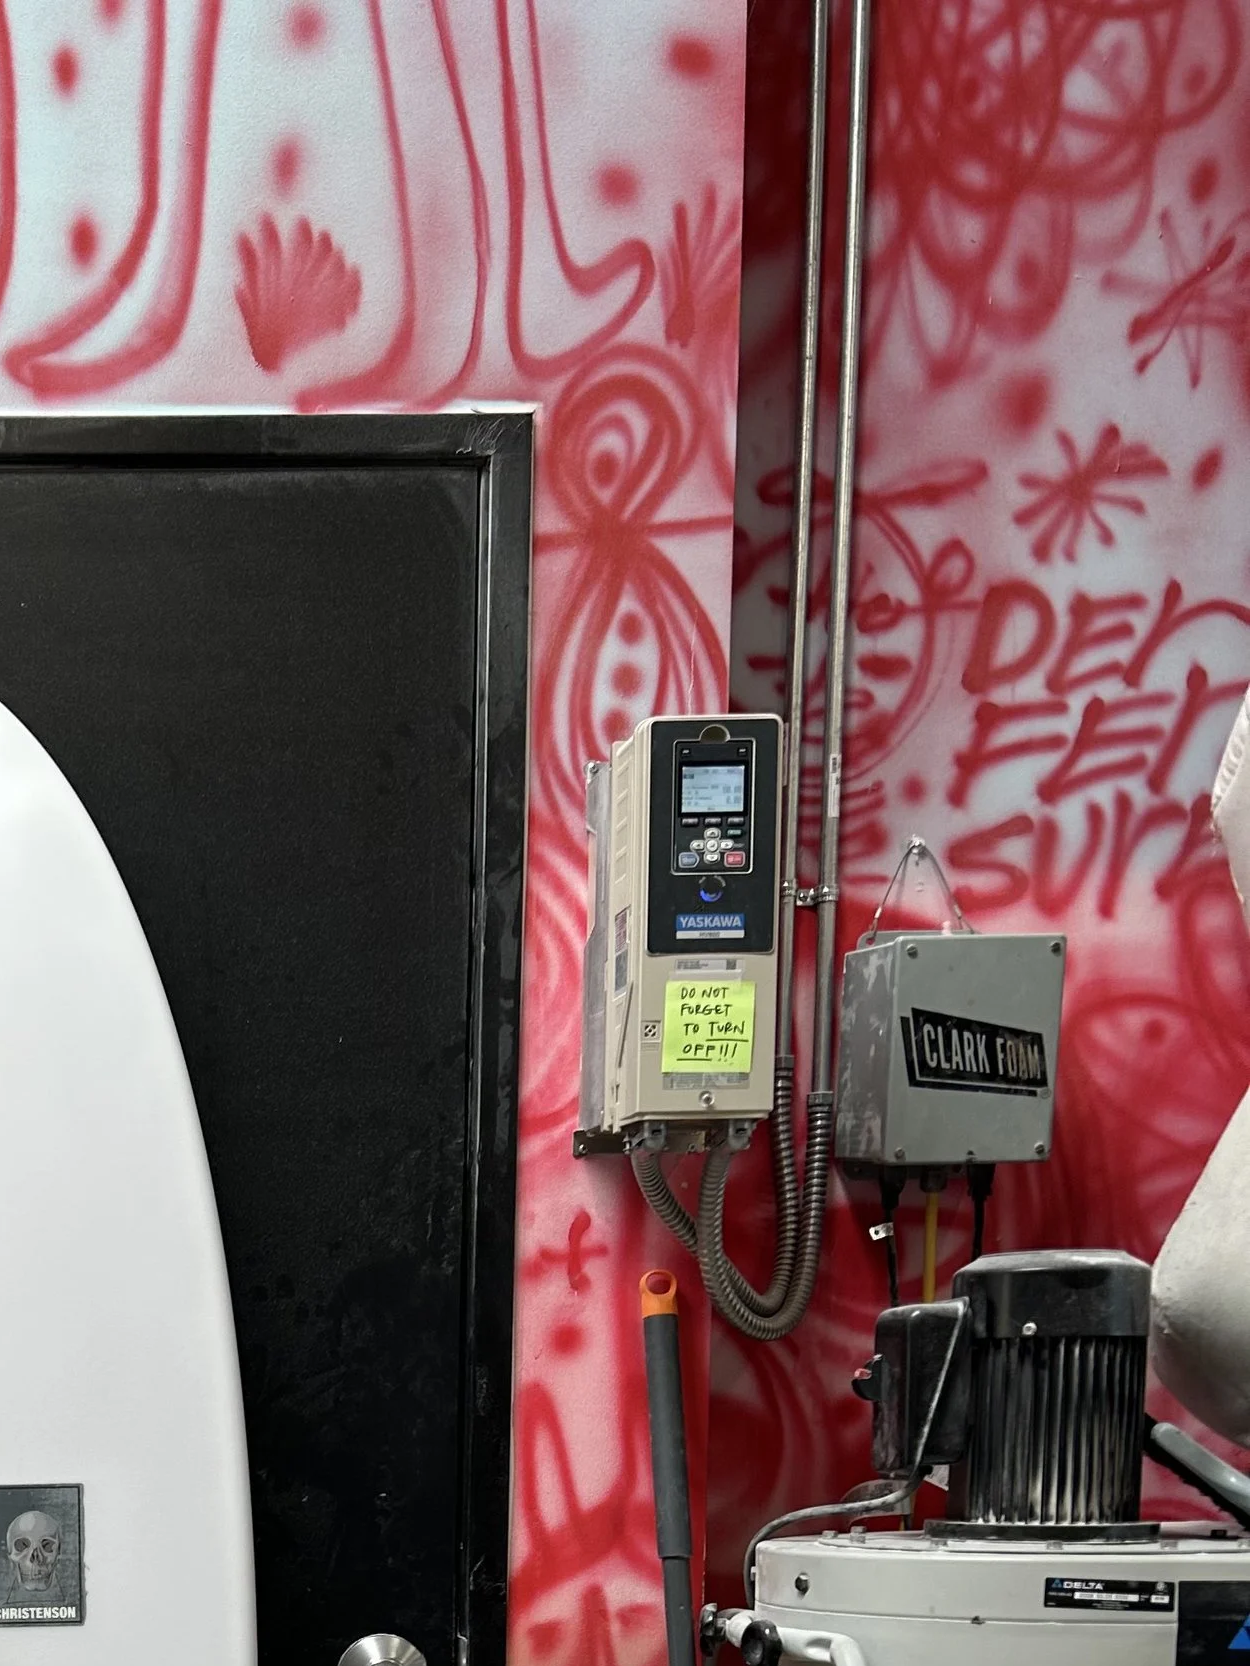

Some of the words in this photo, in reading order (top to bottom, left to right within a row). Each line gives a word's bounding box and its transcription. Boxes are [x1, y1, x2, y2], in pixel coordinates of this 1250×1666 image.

[680, 915, 742, 929] YASKAWA
[681, 987, 696, 1000] DO
[701, 986, 729, 999] NOT
[680, 1003, 733, 1017] FORGET
[683, 1022, 700, 1036] TO
[708, 1021, 745, 1037] TURN
[923, 1023, 991, 1074] CLARK
[996, 1037, 1041, 1080] FOAM
[1062, 1581, 1104, 1590] DELTA
